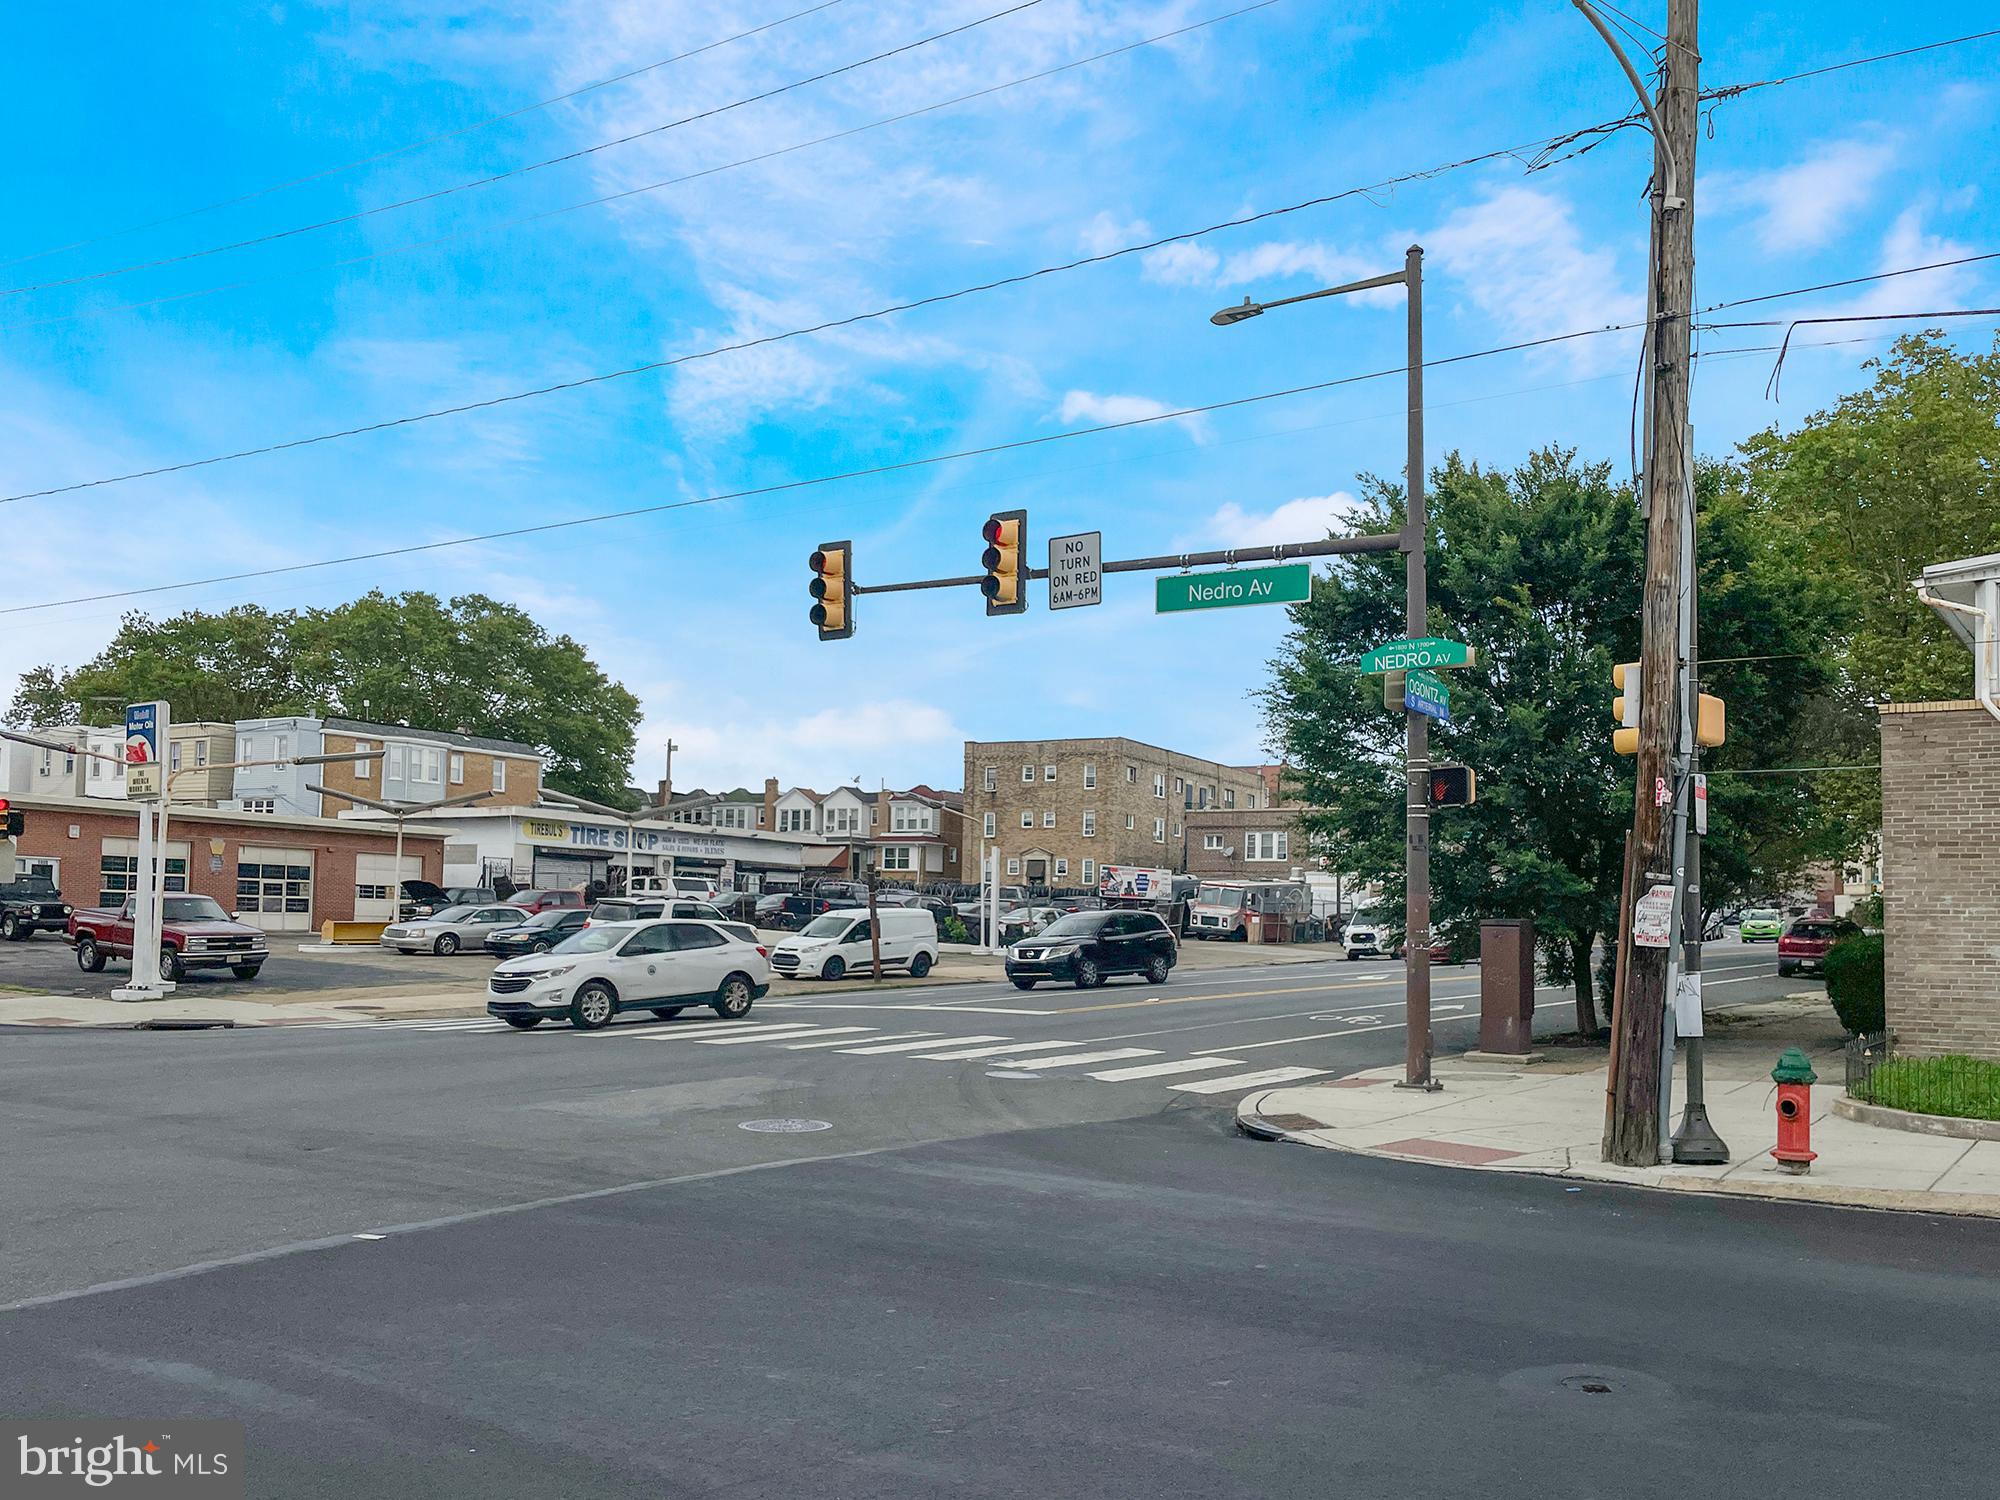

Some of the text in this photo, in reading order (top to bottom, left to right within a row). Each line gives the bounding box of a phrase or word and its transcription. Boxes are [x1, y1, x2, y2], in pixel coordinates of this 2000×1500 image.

[1065, 541, 1084, 554] NO
[1060, 555, 1090, 570] TURN
[1053, 570, 1097, 588] ON RED
[1053, 586, 1098, 604] 6AM-6PM
[1188, 578, 1273, 602] Nedro Av
[1408, 642, 1415, 650] N
[1374, 651, 1451, 671] NEDRO AV
[1409, 679, 1439, 703] OGONTZ
[1410, 695, 1416, 707] S
[570, 825, 659, 850] TIRE SHOP
